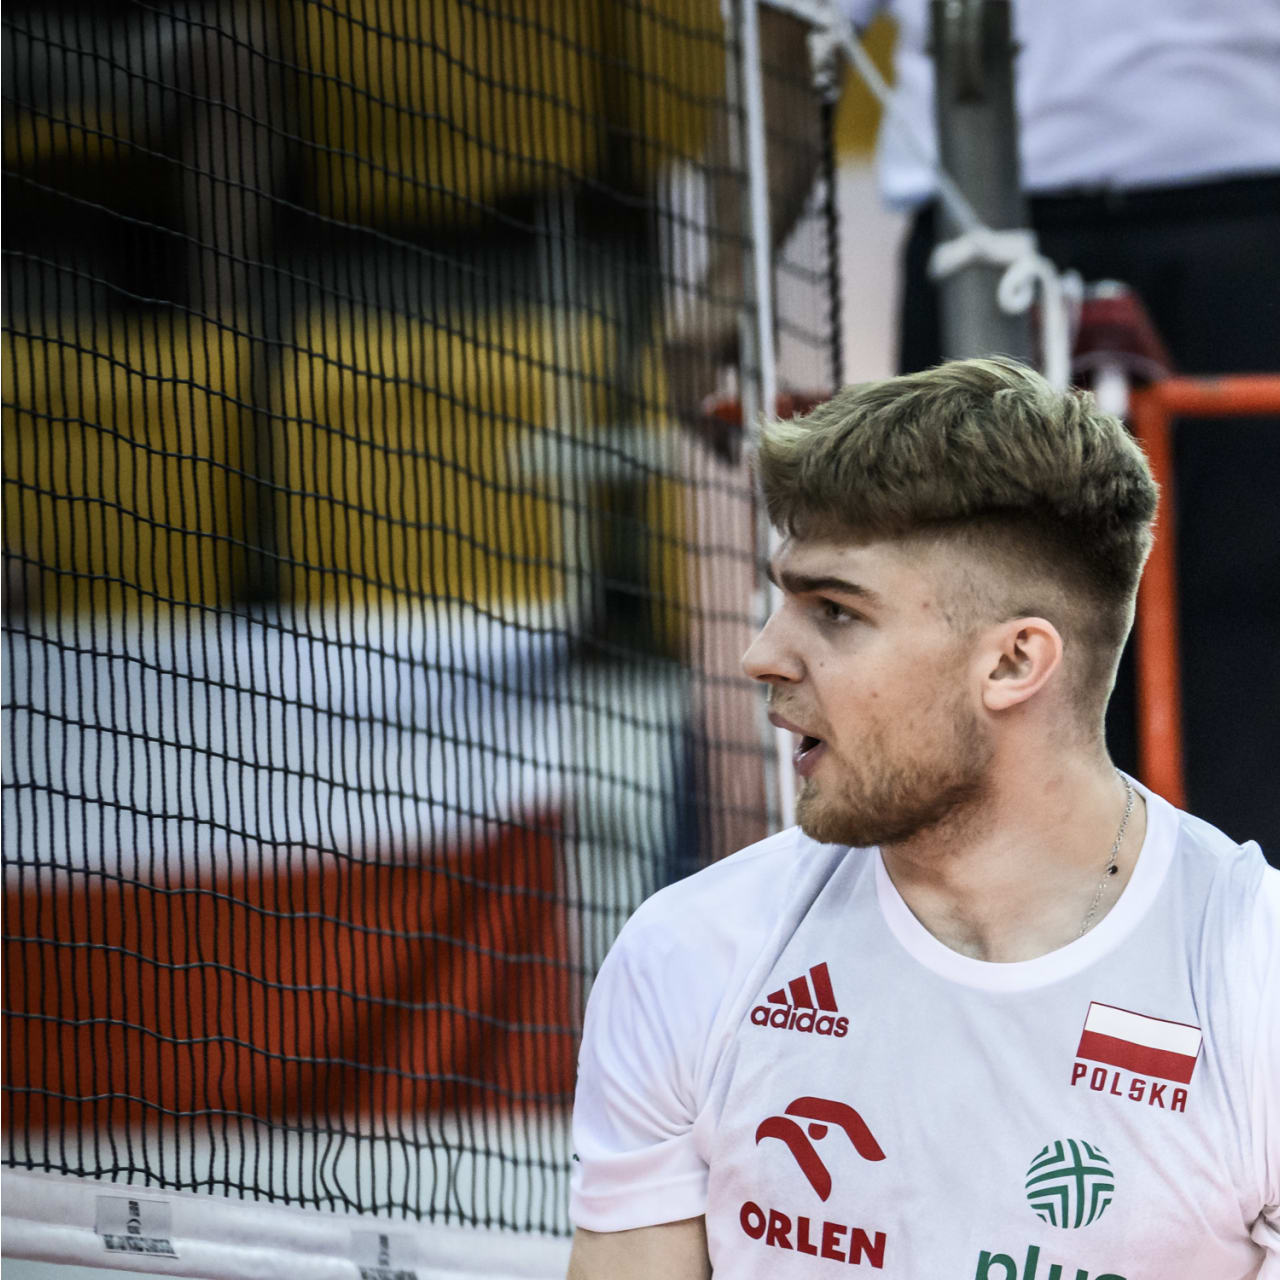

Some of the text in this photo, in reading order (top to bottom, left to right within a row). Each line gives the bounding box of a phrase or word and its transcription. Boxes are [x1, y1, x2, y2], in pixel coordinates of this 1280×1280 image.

[750, 1003, 849, 1038] adidas
[1071, 1062, 1188, 1113] POLSKA
[740, 1201, 887, 1269] ORLEN
